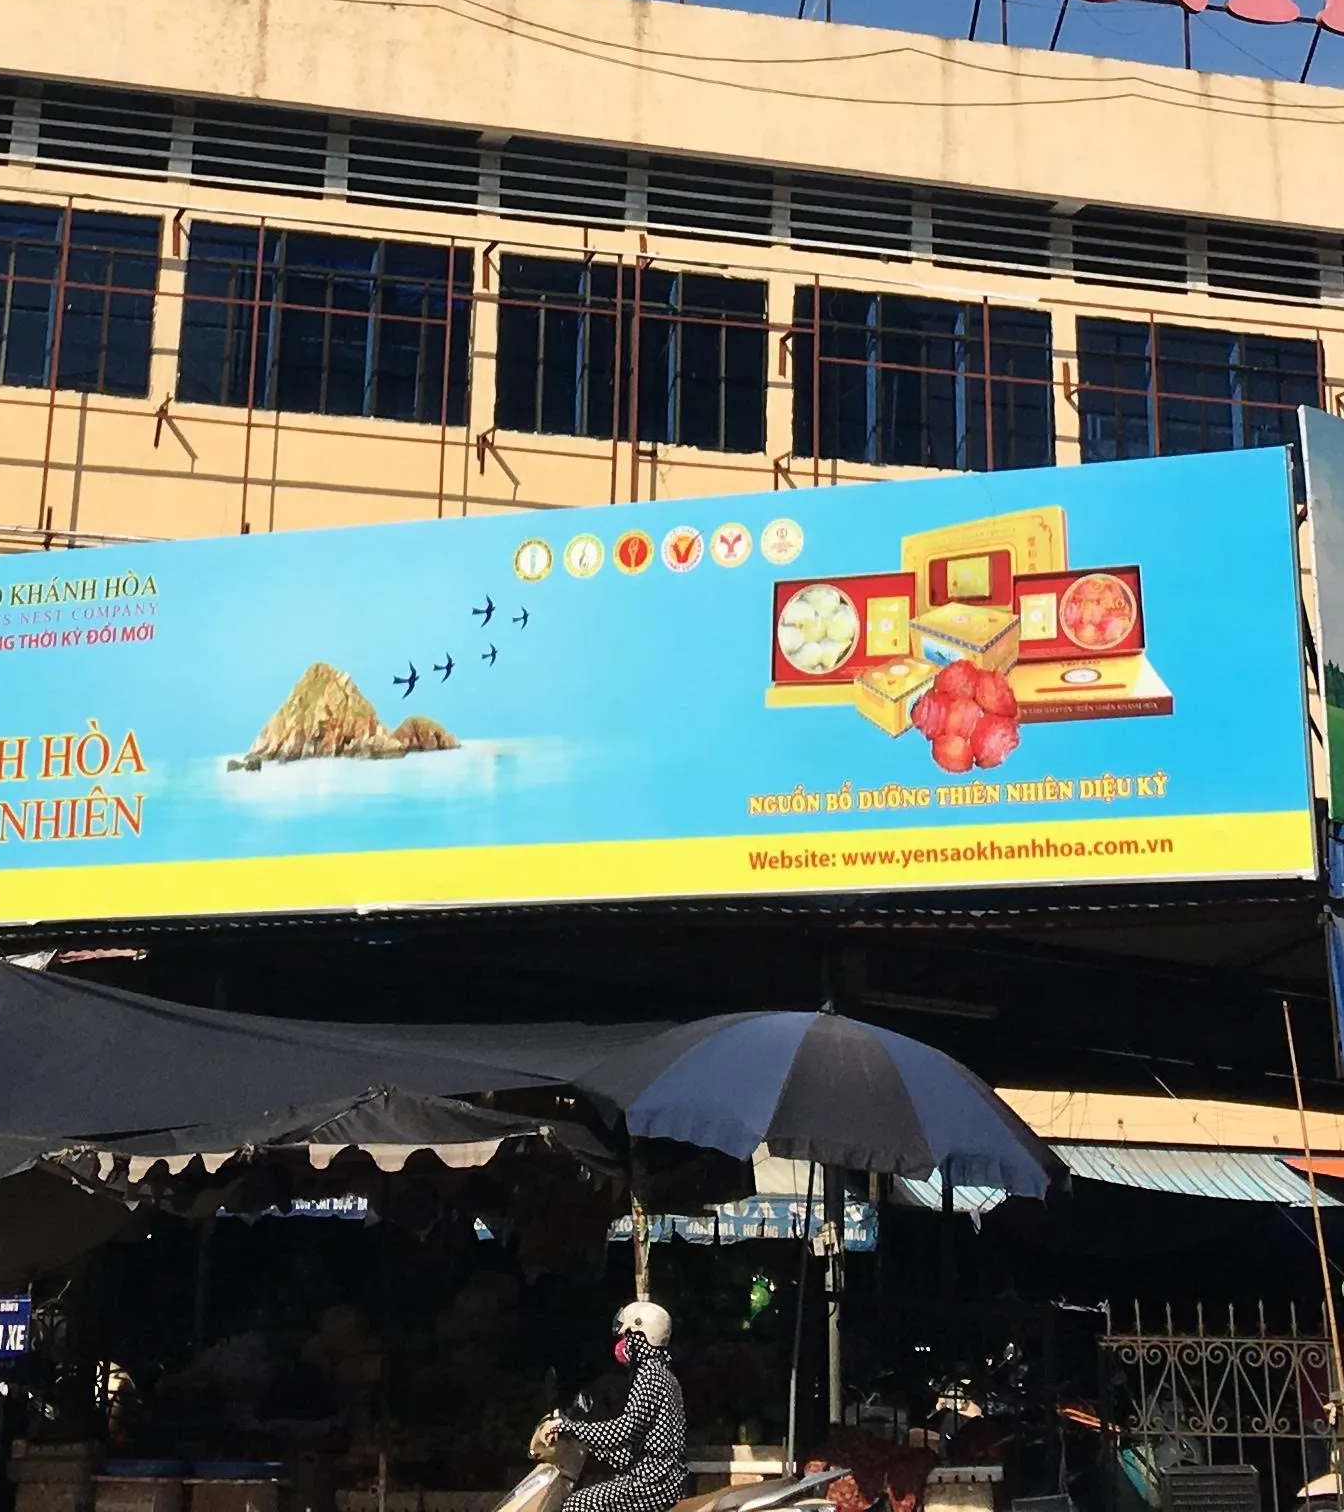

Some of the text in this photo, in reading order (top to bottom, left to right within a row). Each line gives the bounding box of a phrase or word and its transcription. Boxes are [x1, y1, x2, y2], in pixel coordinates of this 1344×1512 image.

[9, 576, 97, 607] KHÁNH
[103, 569, 157, 599] HÒA
[120, 623, 156, 642] MỚI
[41, 718, 150, 781] HÒA
[936, 779, 1002, 806] THIÊN
[1006, 775, 1074, 803] NHIÊN
[1078, 773, 1133, 803] DIỆU
[749, 837, 1174, 871] Website: www.yensaokhanhhoa.com.vn
